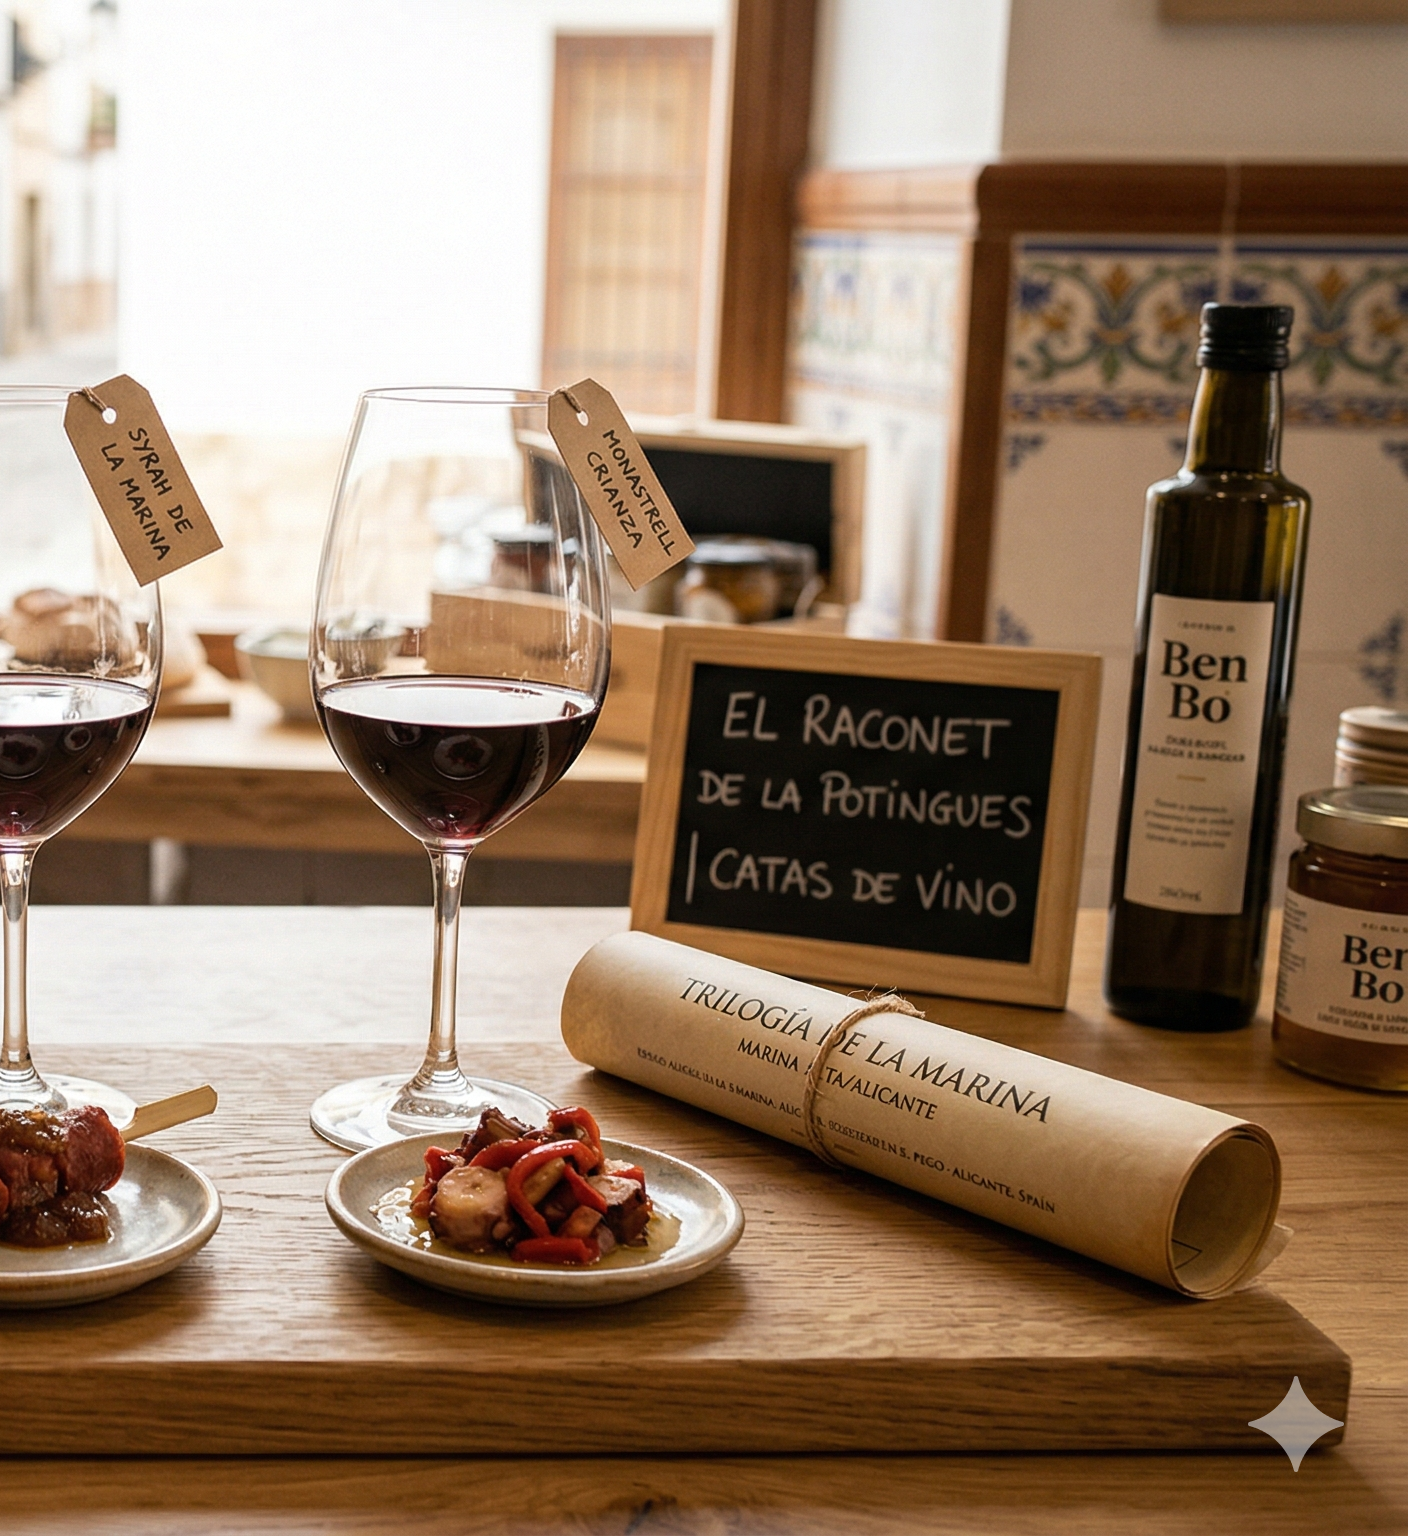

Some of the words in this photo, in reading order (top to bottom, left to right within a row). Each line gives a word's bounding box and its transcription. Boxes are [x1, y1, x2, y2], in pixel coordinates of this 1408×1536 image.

[101, 443, 125, 472] LA
[119, 478, 171, 561] MARINA
[128, 427, 172, 496] SYRAH
[167, 504, 193, 534] DE
[587, 451, 643, 549] CRIANZA
[602, 429, 678, 557] MONASTRELL
[1161, 638, 1248, 683] Ben
[723, 691, 779, 741] EL
[803, 694, 1012, 760] RACONET
[1168, 682, 1232, 723] Bo
[697, 770, 745, 806] DE
[761, 778, 801, 814] LA
[709, 847, 833, 900] CATAS
[852, 868, 900, 904] DE
[1351, 968, 1404, 1004] Bo
[679, 977, 813, 1041] TRILOGÍA
[865, 1040, 908, 1073] LA
[909, 1056, 1052, 1124] MARINA
[737, 1038, 799, 1072] MARINA
